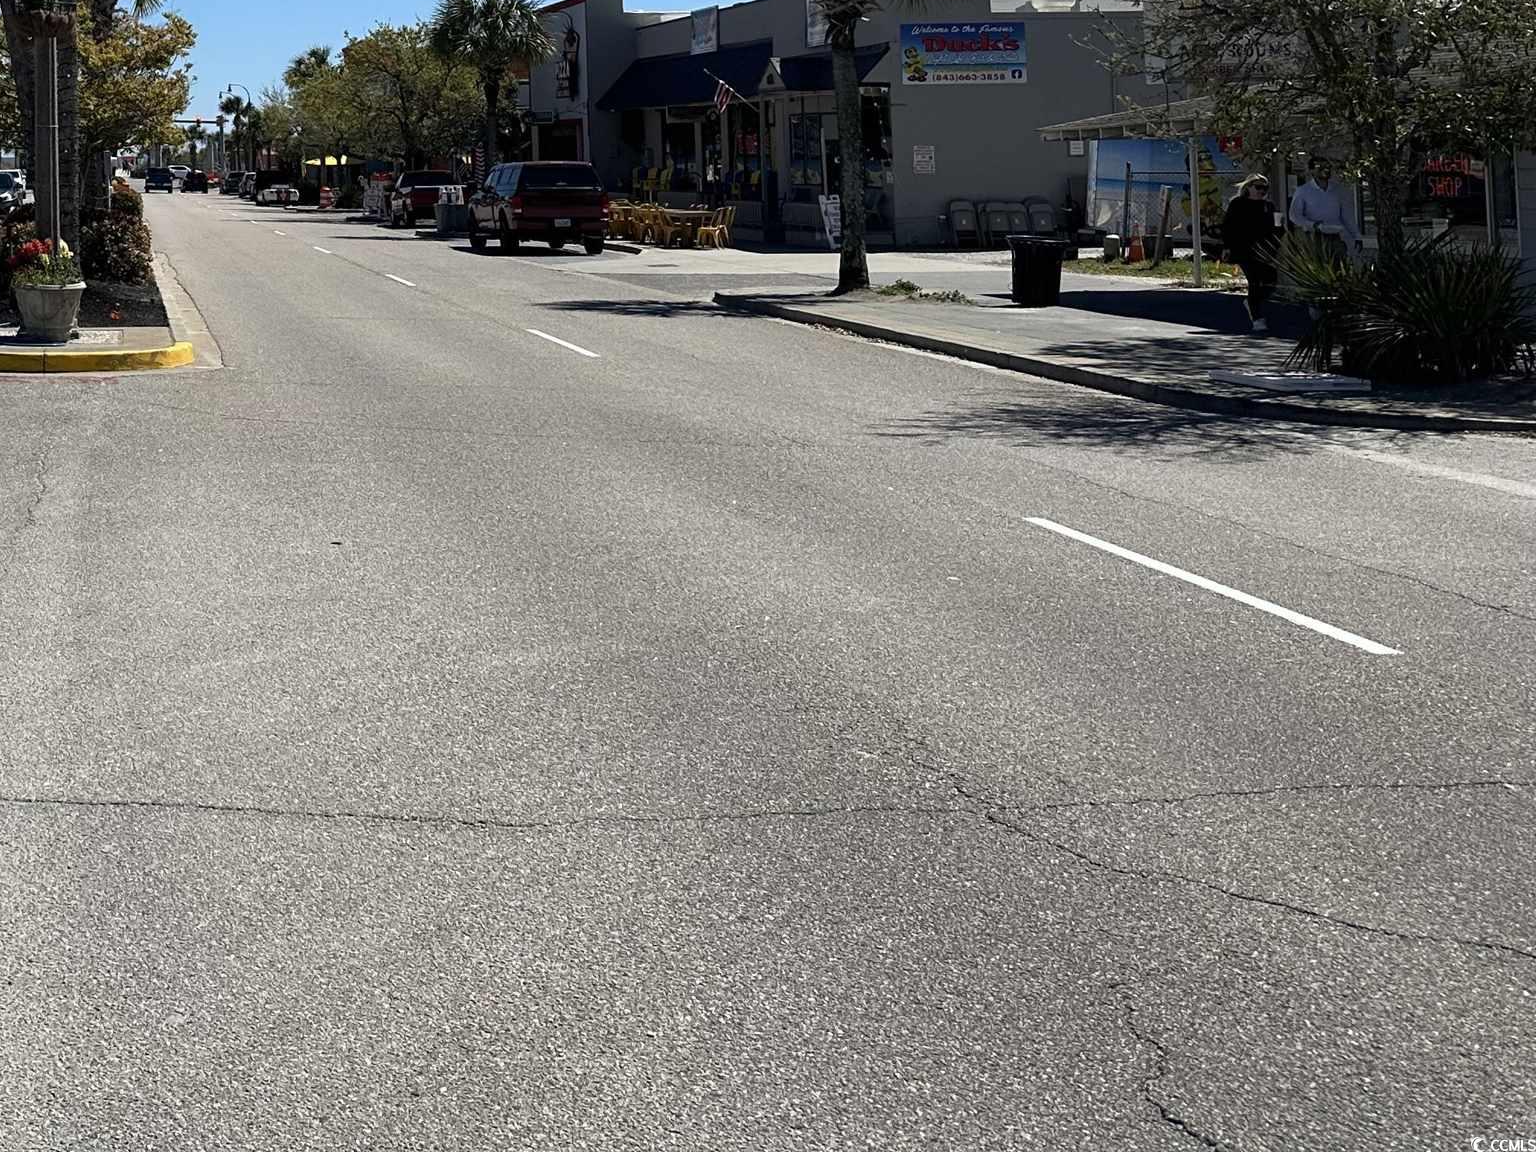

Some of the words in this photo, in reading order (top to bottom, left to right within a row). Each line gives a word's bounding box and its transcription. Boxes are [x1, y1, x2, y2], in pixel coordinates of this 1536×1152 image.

[912, 25, 949, 35] Welcome
[951, 25, 961, 33] to
[962, 25, 976, 33] the
[923, 33, 1020, 53] Duck's
